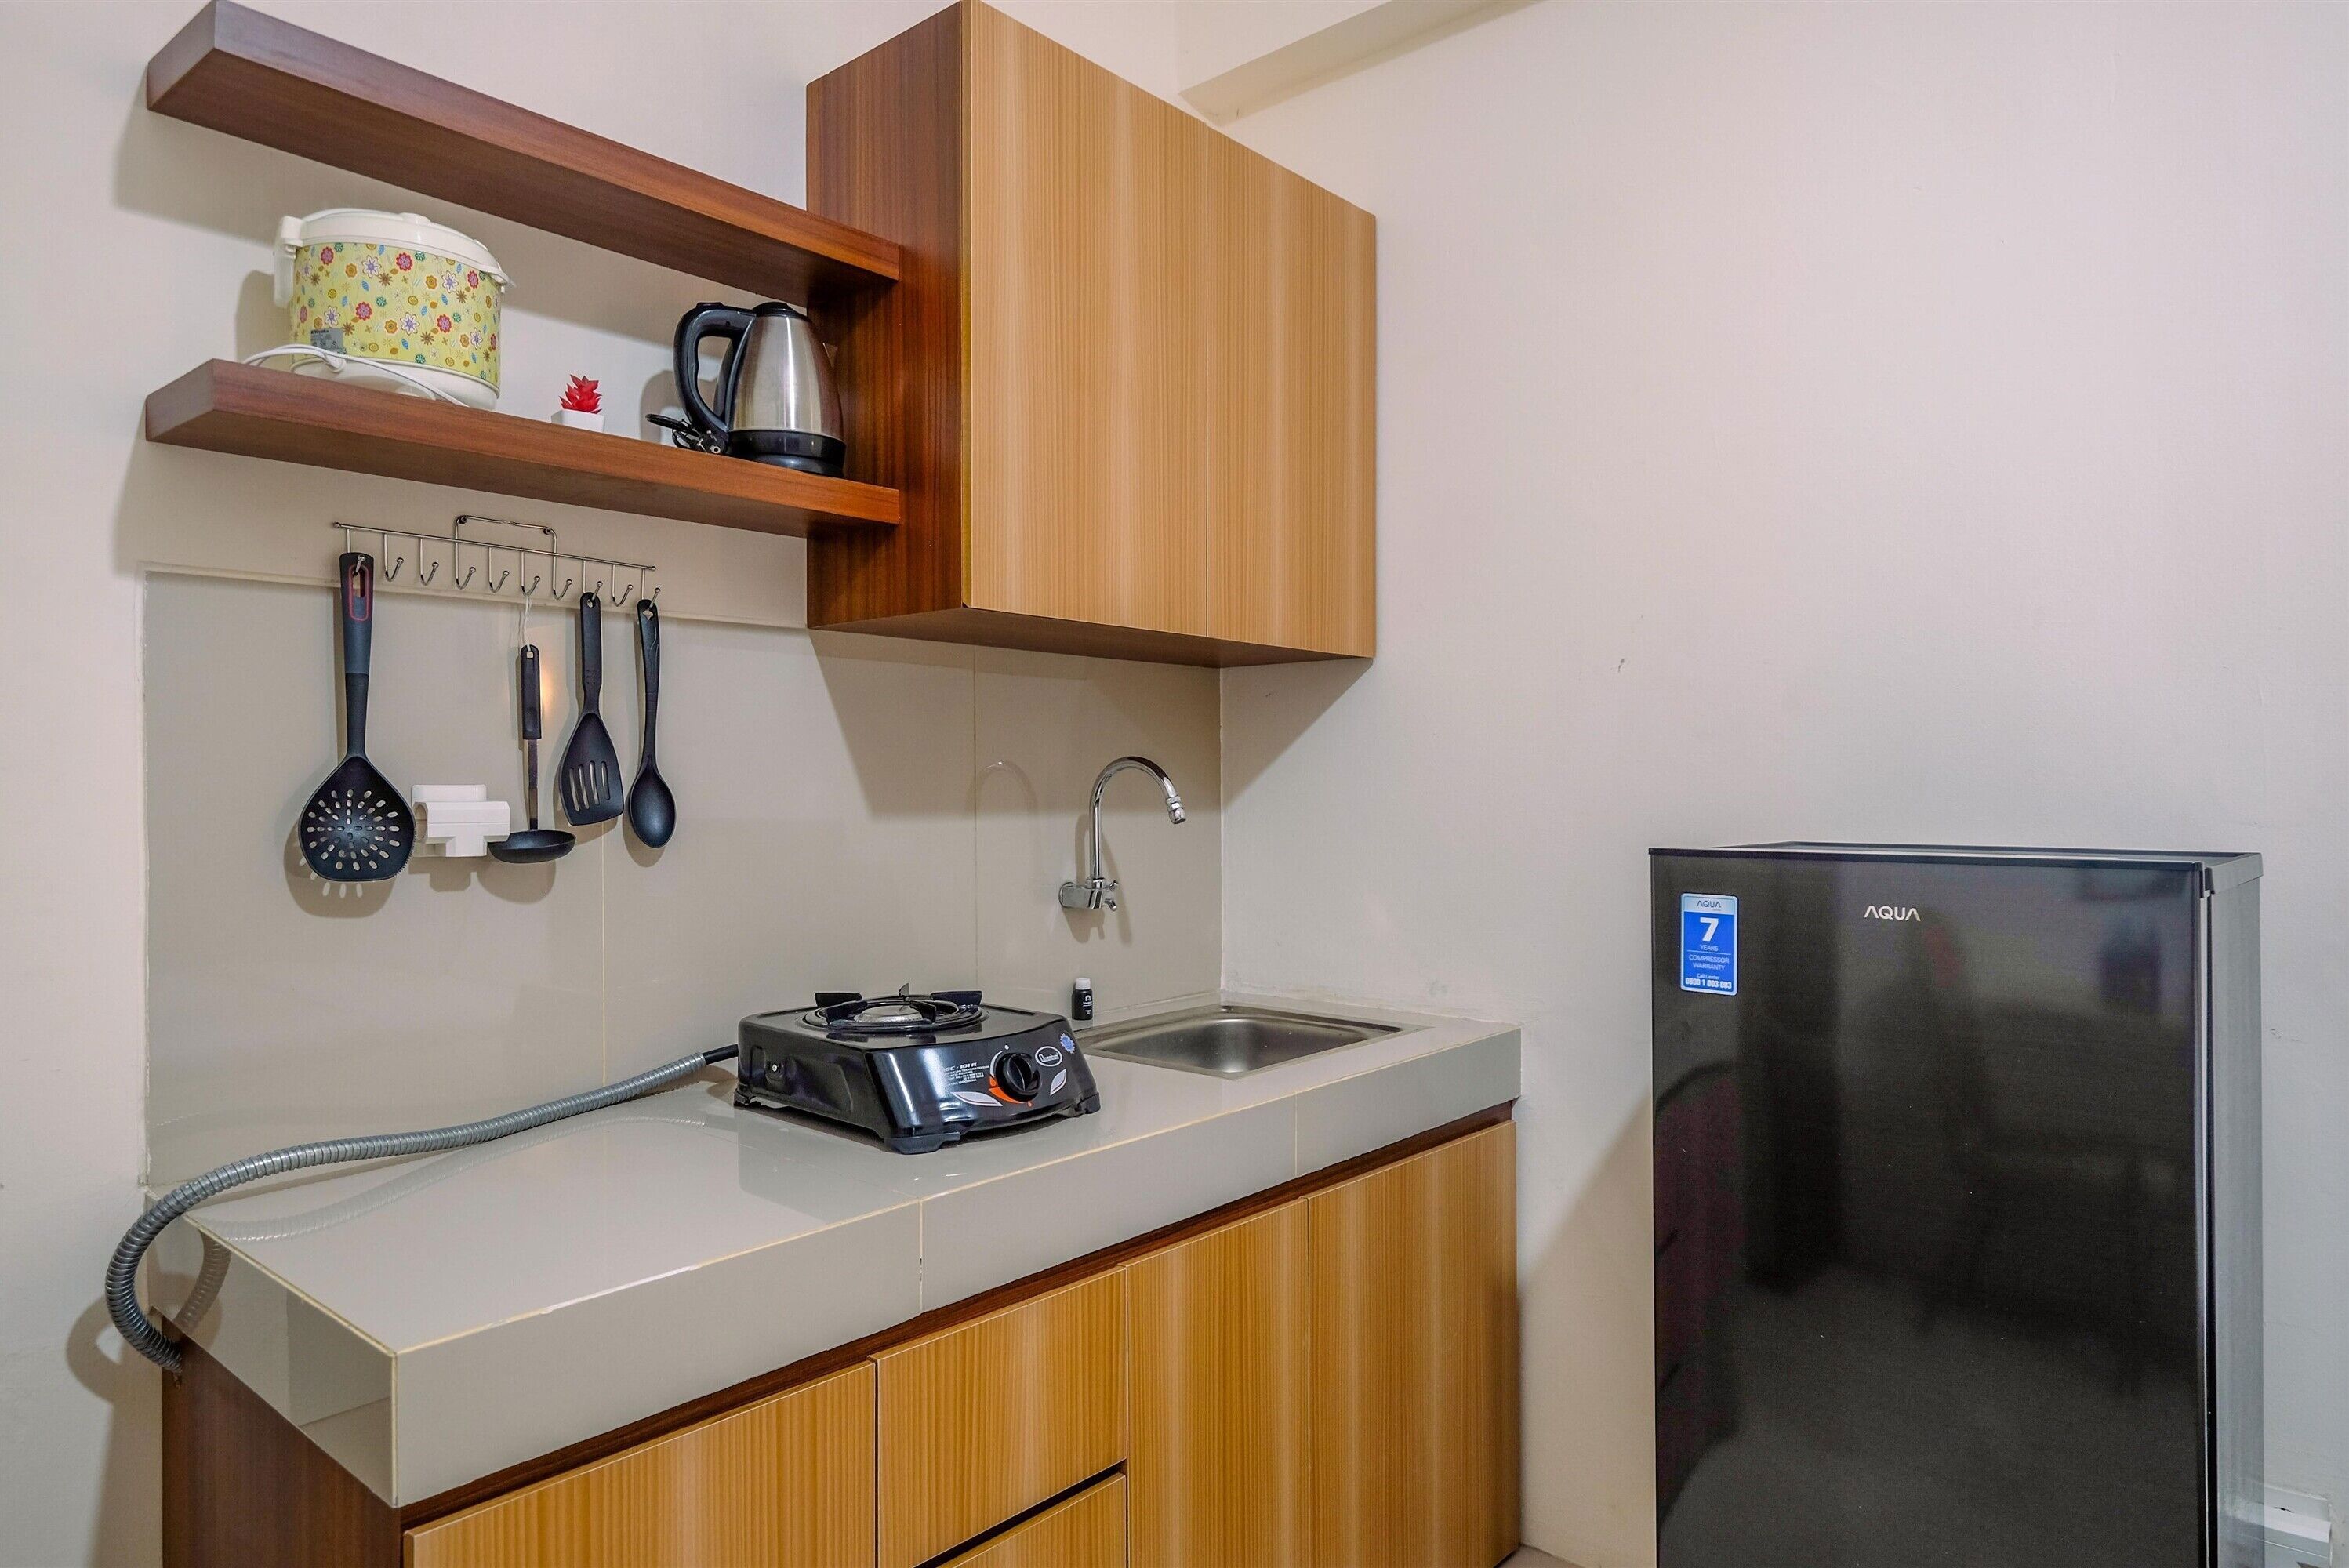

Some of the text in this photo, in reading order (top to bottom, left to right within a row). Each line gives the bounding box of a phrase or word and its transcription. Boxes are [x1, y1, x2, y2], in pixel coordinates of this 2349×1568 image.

[1864, 905, 1922, 922] AQUA
[1700, 916, 1719, 942] 7
[1689, 954, 1730, 964] COMPRESSOR
[1693, 962, 1726, 971] WARRANTY
